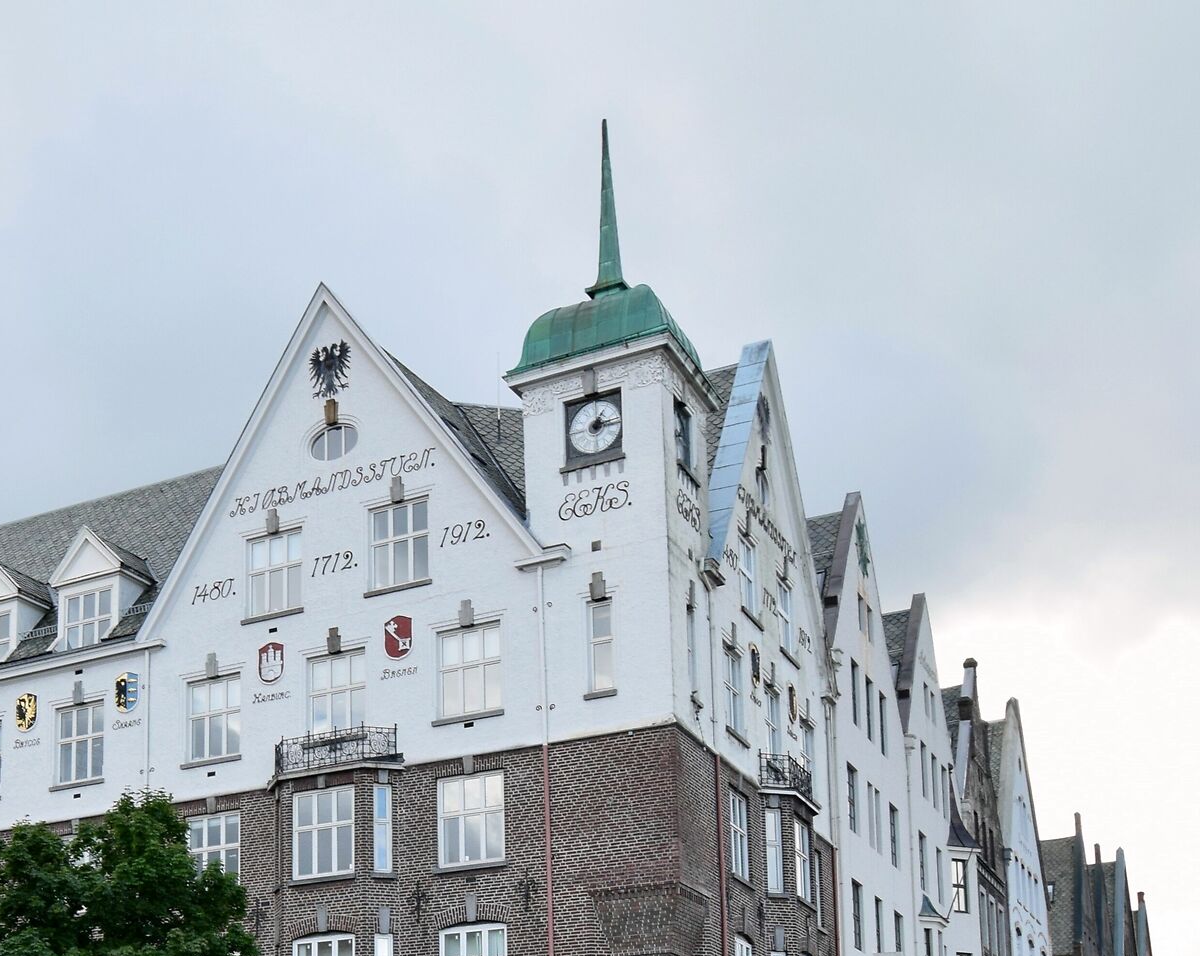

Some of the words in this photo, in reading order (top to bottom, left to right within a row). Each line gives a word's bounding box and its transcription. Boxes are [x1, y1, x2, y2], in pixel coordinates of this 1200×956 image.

[440, 519, 491, 548] 1912.
[311, 550, 359, 578] 1712.
[191, 577, 237, 606] 1480.
